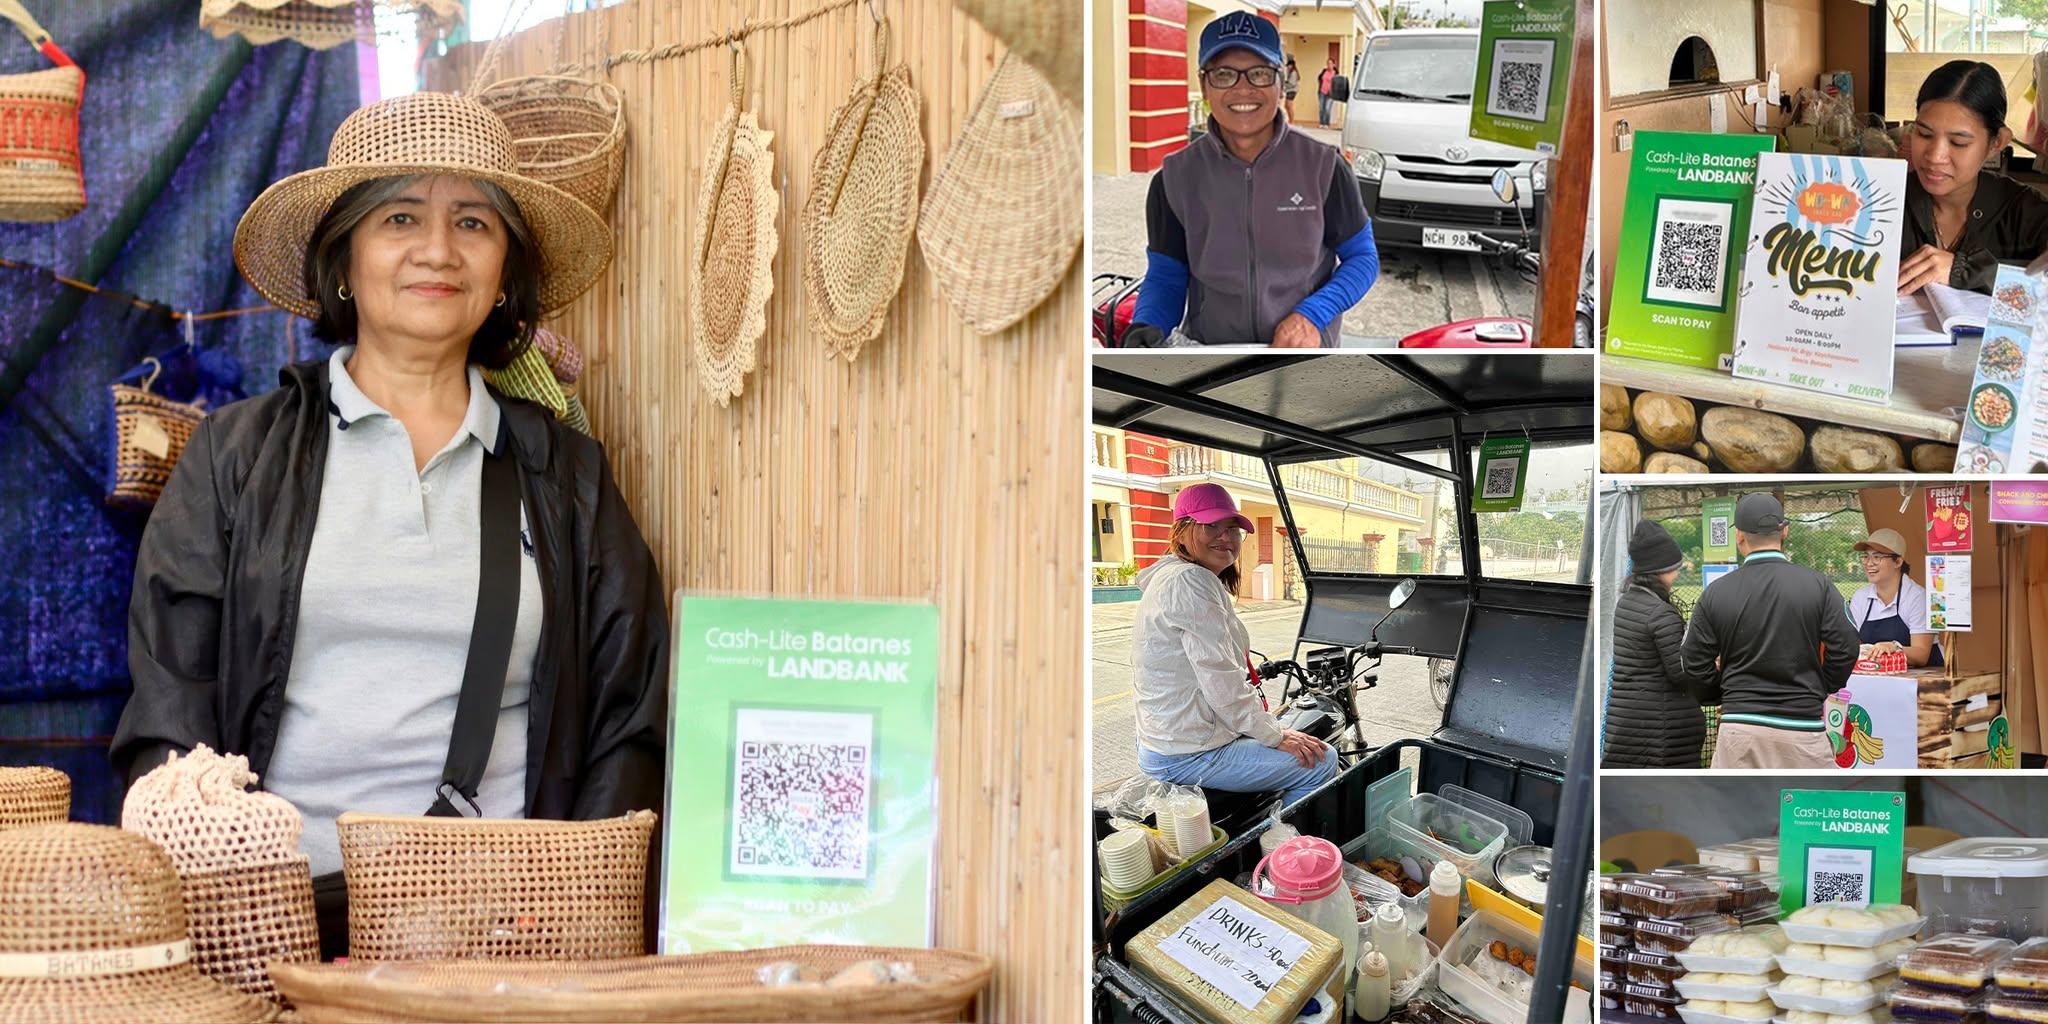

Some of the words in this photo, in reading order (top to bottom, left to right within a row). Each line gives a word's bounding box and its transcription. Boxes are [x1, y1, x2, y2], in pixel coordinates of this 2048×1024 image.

[1218, 14, 1260, 39] LA
[1511, 23, 1561, 33] LANDBANK
[1646, 150, 1700, 164] Cash-Lite
[1702, 153, 1757, 168] Batanes
[1677, 168, 1754, 185] LANDBANK
[1424, 232, 1445, 245] NCH
[1763, 222, 1881, 296] Menu
[1789, 300, 1810, 316] Bon
[1811, 305, 1846, 321] appetit
[1652, 313, 1677, 326] SCAN
[1679, 317, 1691, 327] TO
[1692, 319, 1712, 329] PAY
[1794, 328, 1813, 337] OPEN
[1814, 331, 1833, 340] DAILY
[1736, 364, 1767, 377] DINE-IN
[1789, 373, 1808, 385] TAKE
[1808, 376, 1825, 388] OUT
[1847, 383, 1886, 399] DELIVERY
[1930, 486, 1965, 498] FRENCH
[1935, 497, 1961, 508] FRIES
[704, 627, 807, 652] Cash-Lite
[811, 630, 912, 656] Batanes
[706, 655, 750, 666] Powered
[751, 656, 766, 668] by
[767, 656, 910, 684] LANDBANK
[1793, 806, 1841, 819] Cash-Lite
[1842, 808, 1891, 821] Batanes
[1822, 821, 1890, 834] LANDBANK
[1208, 907, 1268, 949] DRINKS
[48, 952, 135, 975] BATANES
